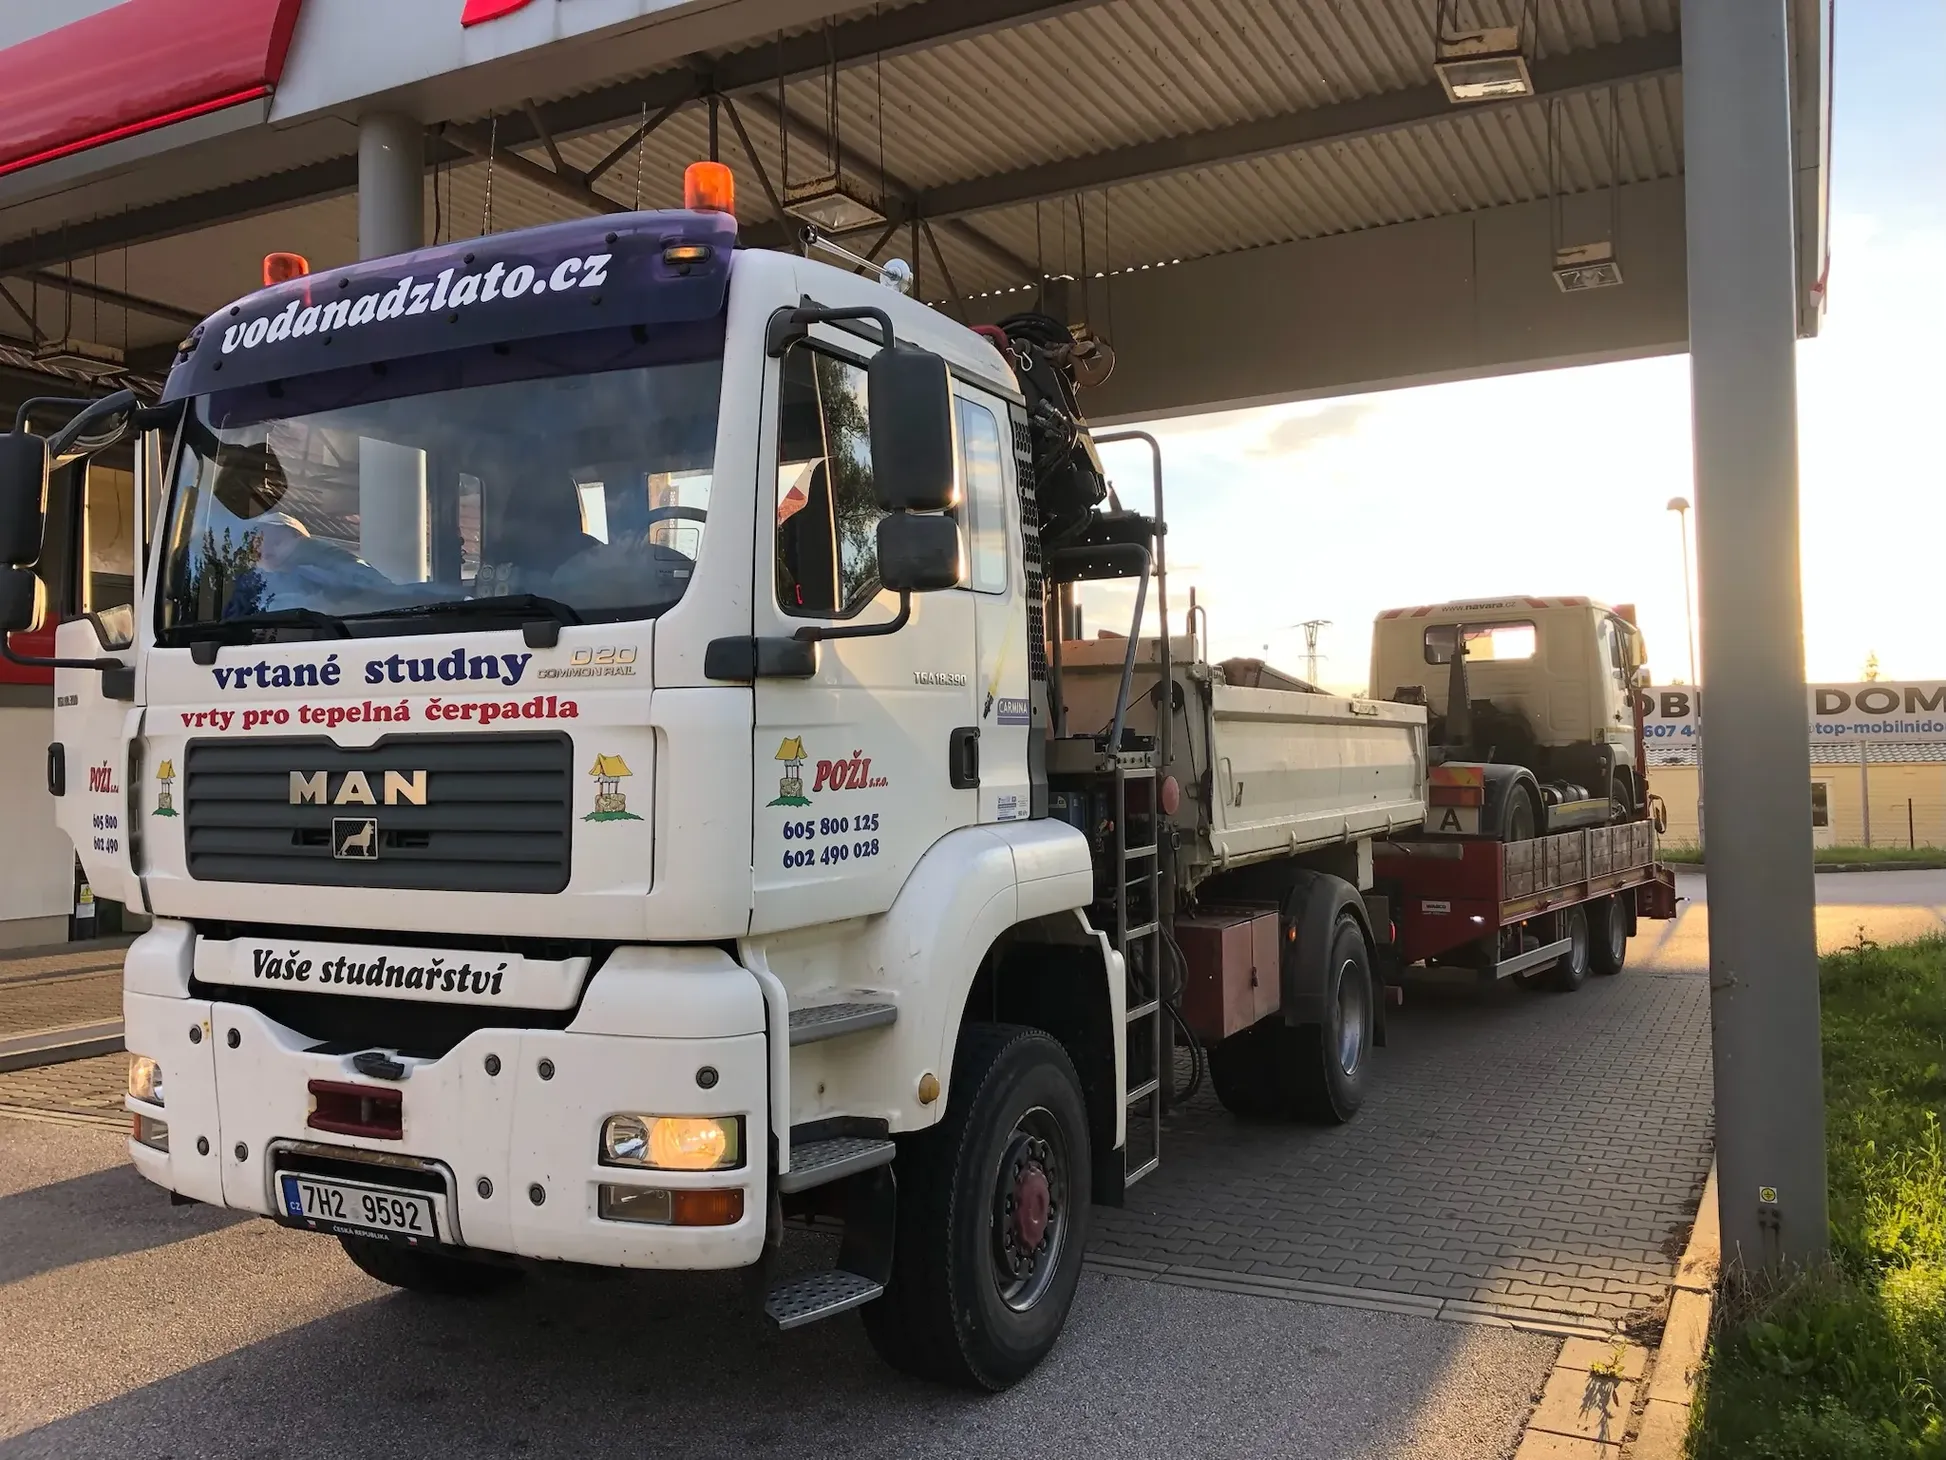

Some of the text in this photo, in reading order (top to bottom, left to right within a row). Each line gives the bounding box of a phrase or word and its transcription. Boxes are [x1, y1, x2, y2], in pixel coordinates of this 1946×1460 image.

[220, 252, 613, 354] vodanadzlato.cz
[212, 648, 532, 690] vrtané studny
[569, 645, 638, 666] D20
[537, 665, 636, 679] COMMON RAIL
[181, 696, 579, 731] vrty pro tepelná čerpadla
[999, 701, 1028, 713] CARMINA
[1643, 724, 1696, 737] 607 4
[89, 760, 112, 793] POŽI
[812, 749, 871, 792] POŽI
[289, 770, 427, 805] MAN
[93, 814, 118, 830] 605 800
[783, 813, 880, 840] 605 800 125
[1440, 808, 1462, 832] A
[93, 836, 119, 854] 602 490
[783, 838, 880, 869] 602 490 028
[253, 949, 508, 996] Vaše studnařství
[289, 1201, 301, 1211] CZ
[302, 1185, 422, 1231] 7H2 9592
[332, 1225, 390, 1241] ČESKÁ REPUBLIKA
